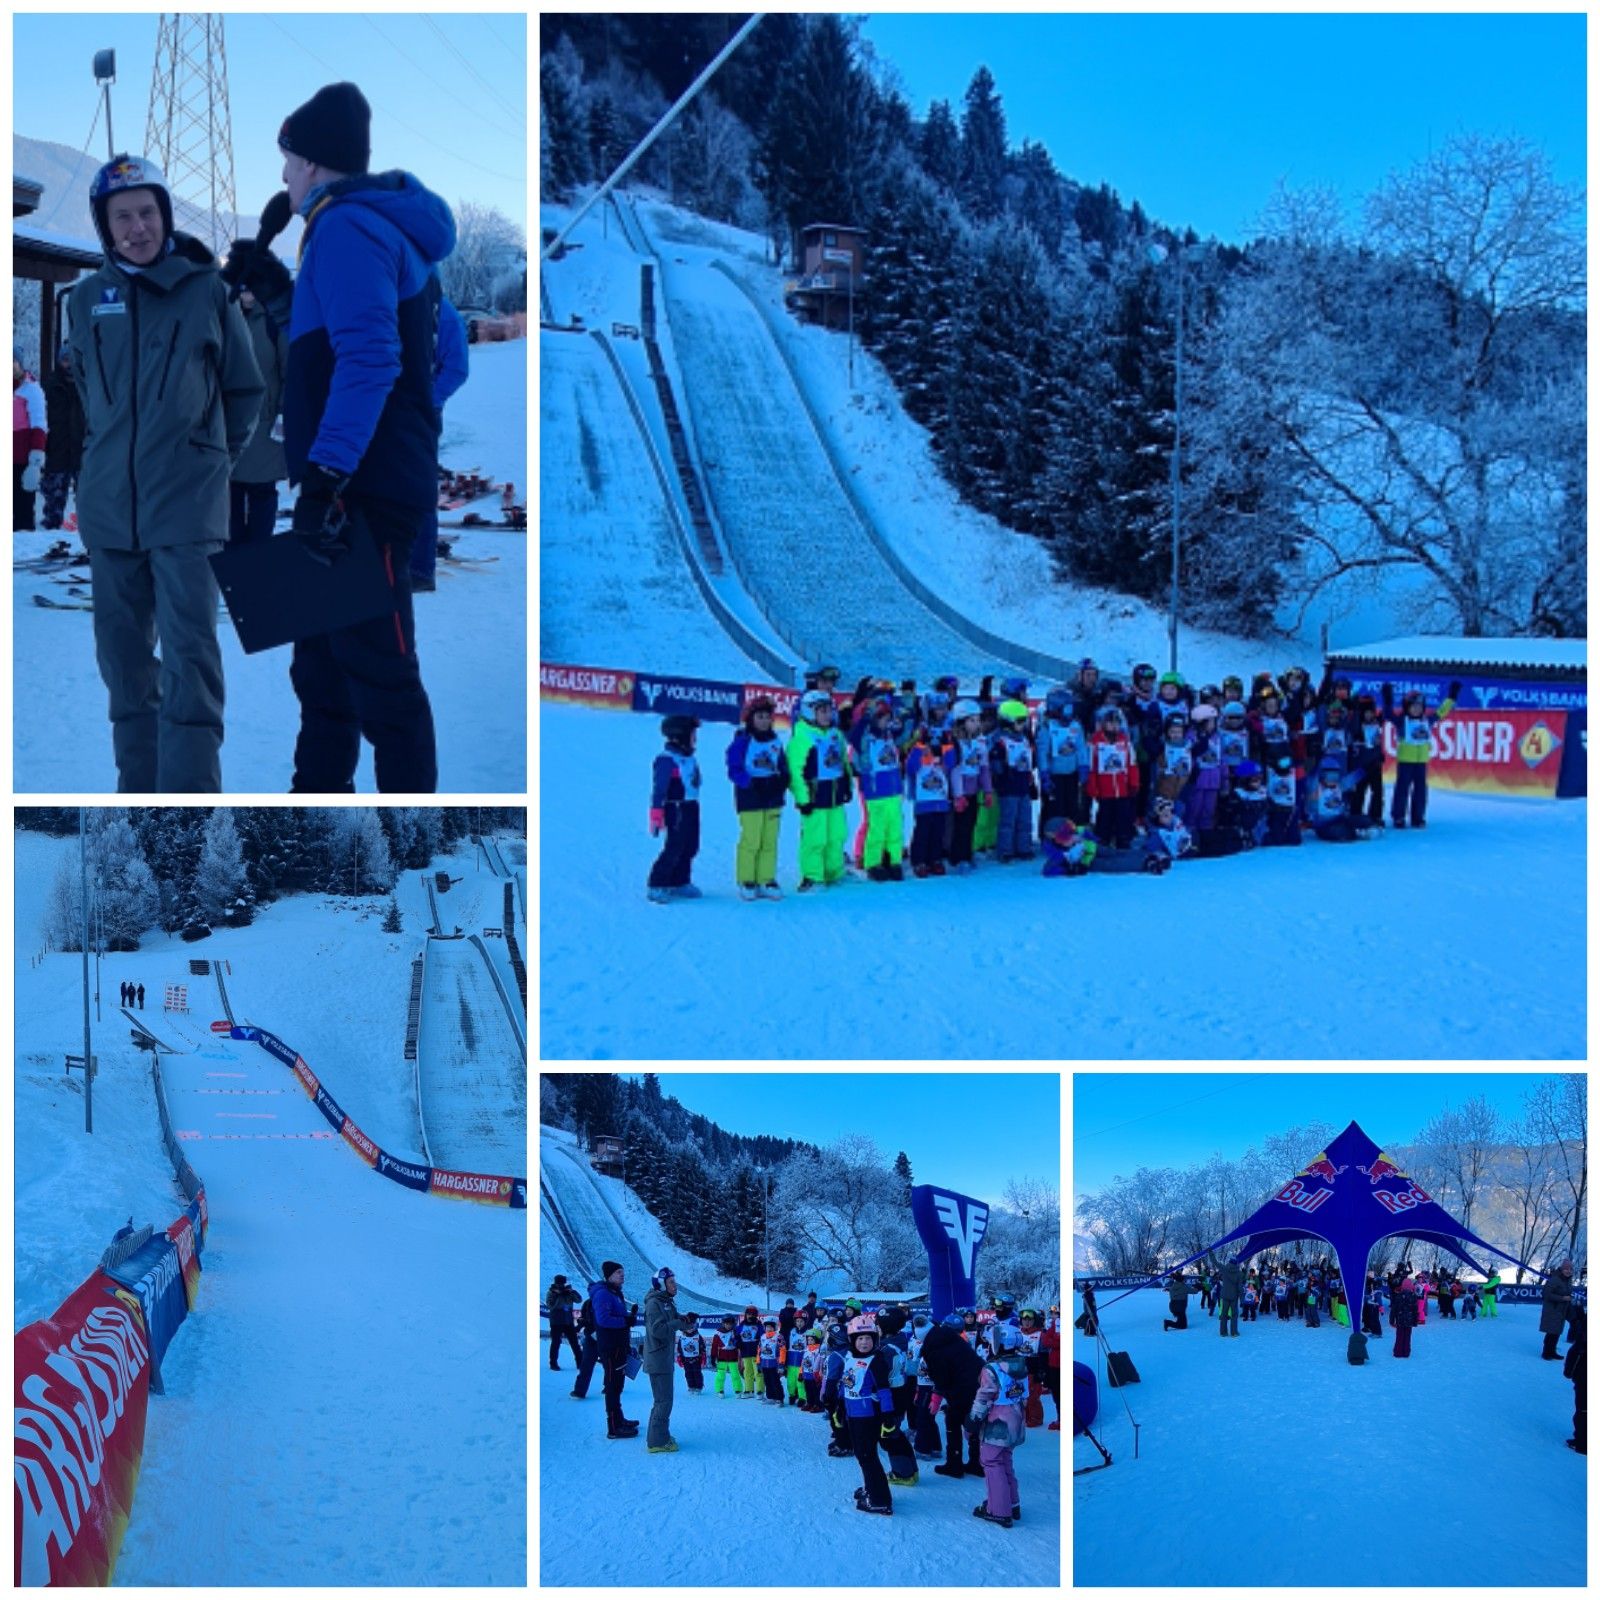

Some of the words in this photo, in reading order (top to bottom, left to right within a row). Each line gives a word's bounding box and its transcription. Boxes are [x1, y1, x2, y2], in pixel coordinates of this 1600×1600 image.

[664, 684, 739, 707] VOLKSBANK
[389, 1160, 427, 1181] VOLKSBANK
[433, 1172, 500, 1194] HARGASSNER
[1274, 1179, 1334, 1214] Bull
[1372, 1180, 1433, 1214] Red
